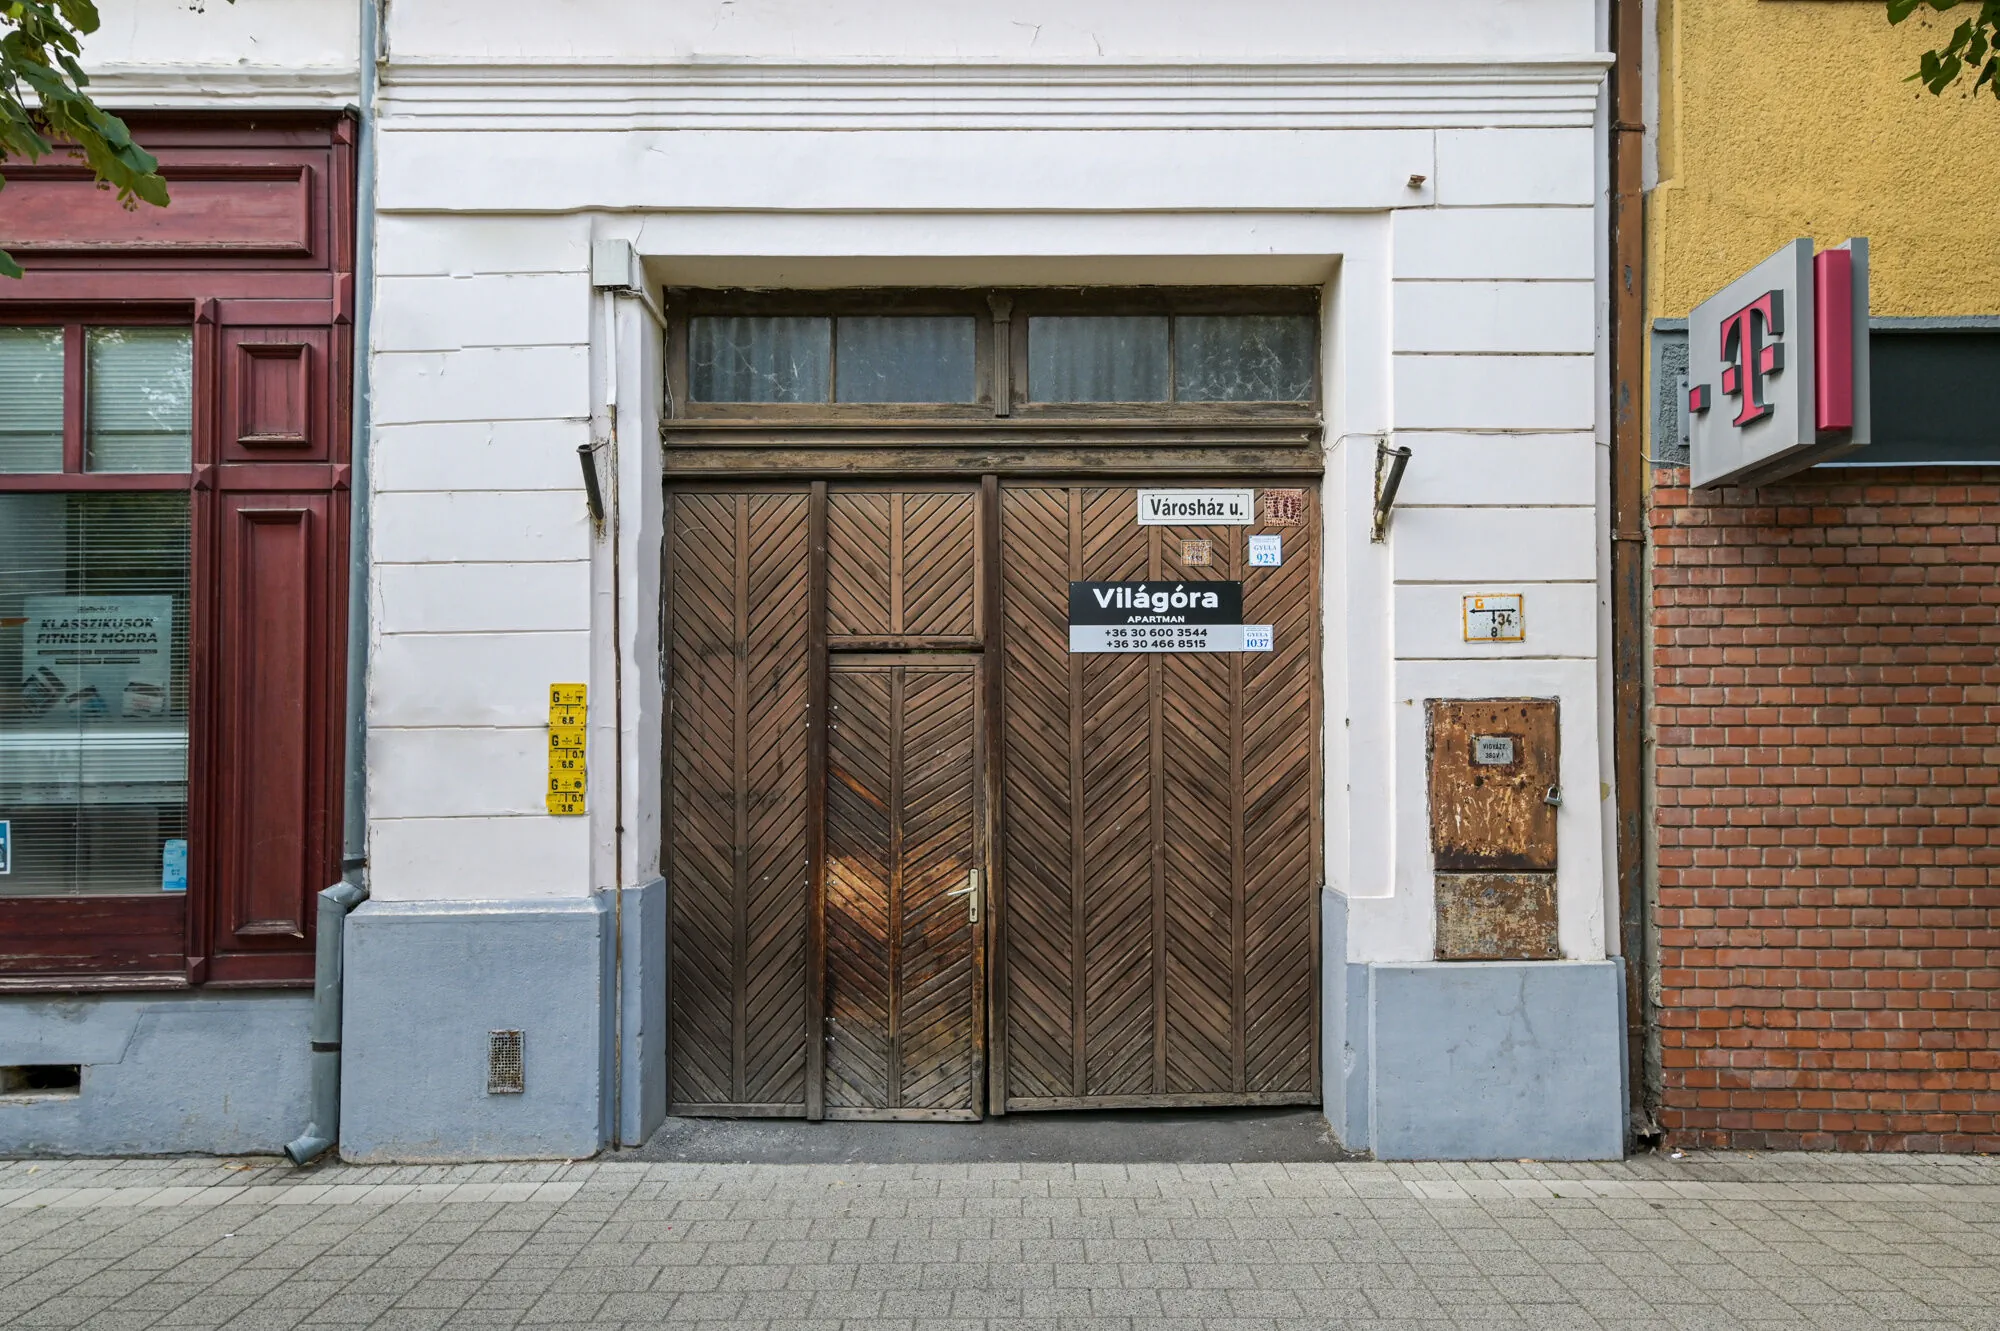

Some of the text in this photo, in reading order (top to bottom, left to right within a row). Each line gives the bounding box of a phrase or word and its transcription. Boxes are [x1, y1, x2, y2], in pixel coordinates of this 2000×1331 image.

[1720, 289, 1784, 427] T
[1150, 498, 1244, 516] Városház u.
[1271, 497, 1299, 519] 10
[1256, 553, 1276, 564] 923
[1092, 584, 1219, 613] Világóra
[1475, 599, 1485, 609] G
[40, 618, 154, 629] KLASSZIKUSOK
[1127, 615, 1185, 623] APARTMAN
[1498, 613, 1512, 626] 34
[37, 629, 158, 644] FITNESZ MÓDRA
[1105, 629, 1208, 637] +36 30 600 3544
[1490, 626, 1498, 637] 8
[1106, 640, 1206, 648] +36 30 466 8515
[1246, 639, 1269, 648] 1037
[552, 691, 560, 703] G
[552, 735, 559, 747] G
[572, 750, 585, 759] 0.7
[562, 760, 574, 769] 6.5
[551, 779, 559, 791] G
[571, 794, 584, 803] 0.7
[561, 804, 574, 813] 3.5
